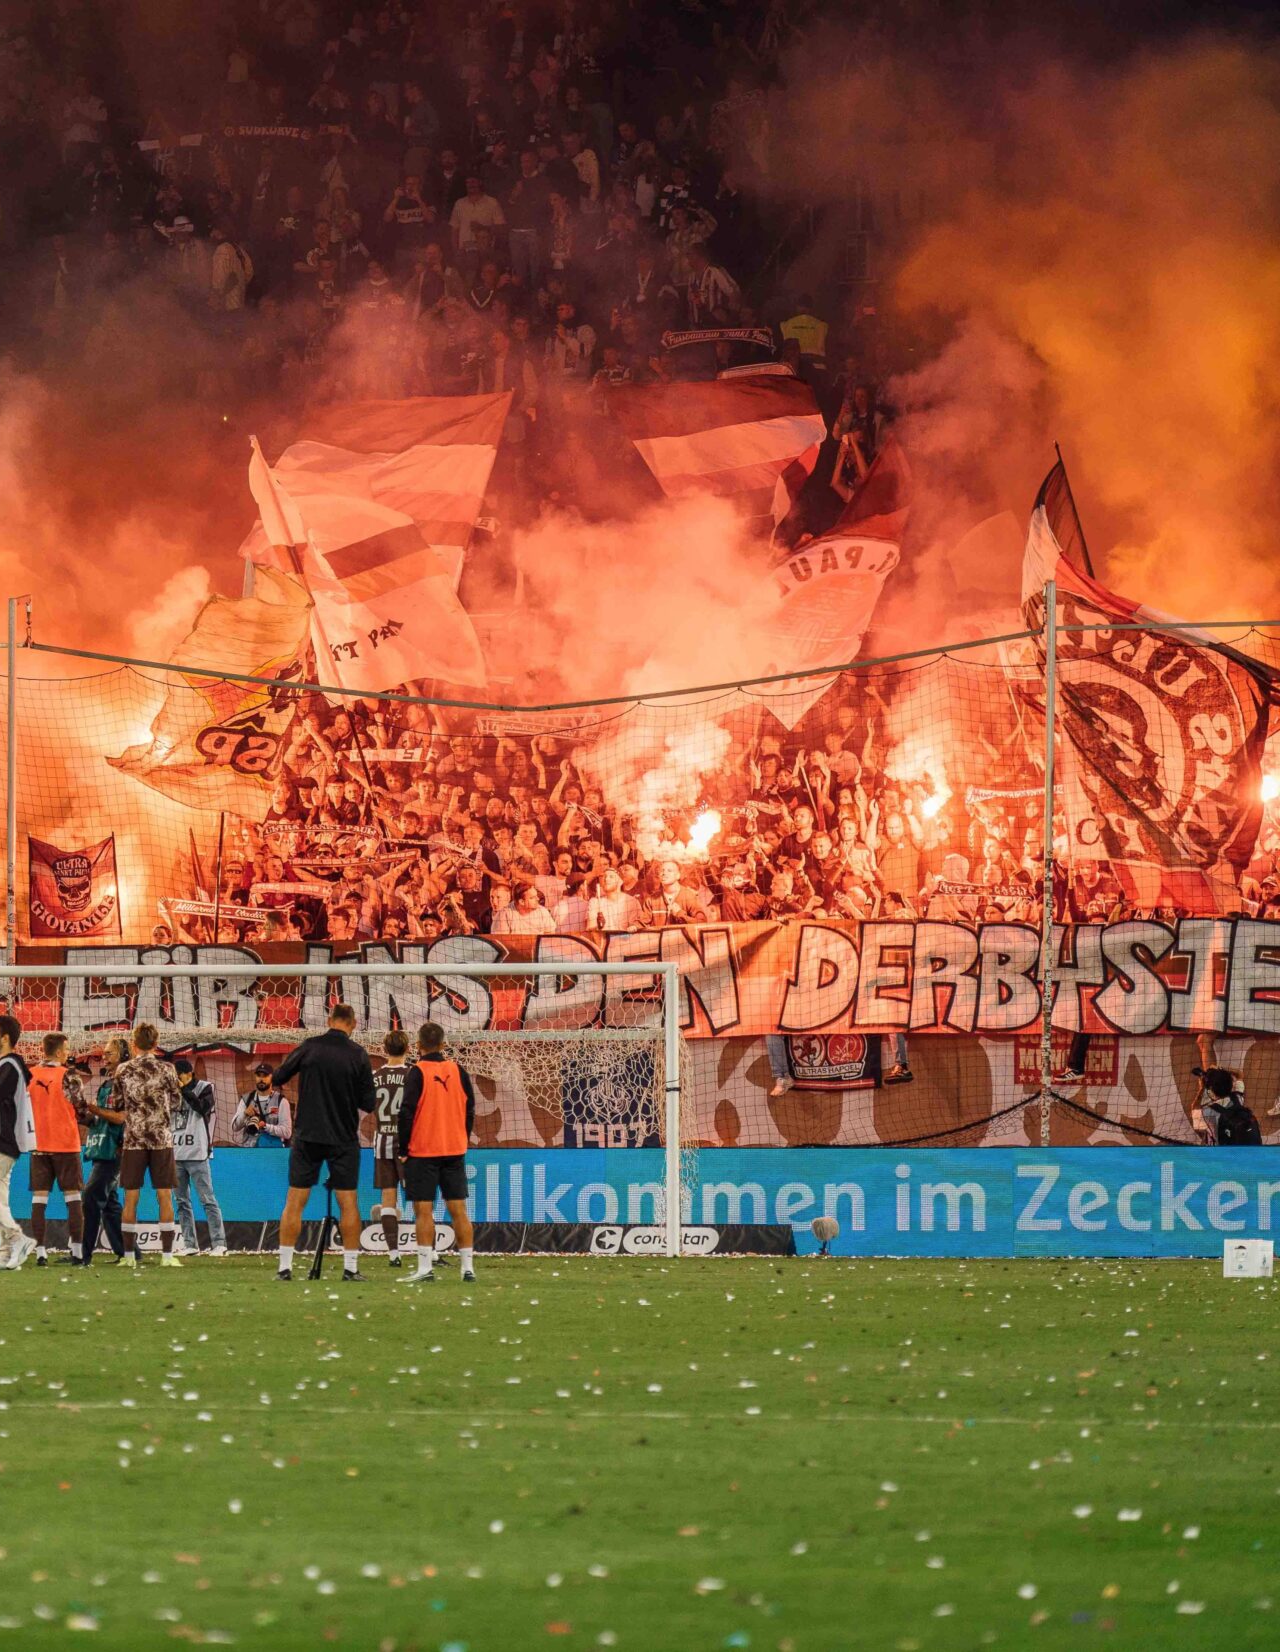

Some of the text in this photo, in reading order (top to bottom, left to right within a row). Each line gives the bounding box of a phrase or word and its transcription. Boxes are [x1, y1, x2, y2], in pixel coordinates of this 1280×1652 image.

[55, 857, 88, 870] ULTRA
[61, 944, 264, 1053] FÜR
[301, 934, 507, 1045] UNS
[522, 928, 742, 1037] DEN
[373, 1074, 405, 1088] ST. PAUL
[797, 1064, 861, 1076] ULTRAS HAPOEL
[375, 1087, 404, 1122] 24
[572, 1119, 647, 1147] 1907
[894, 1163, 988, 1232] im
